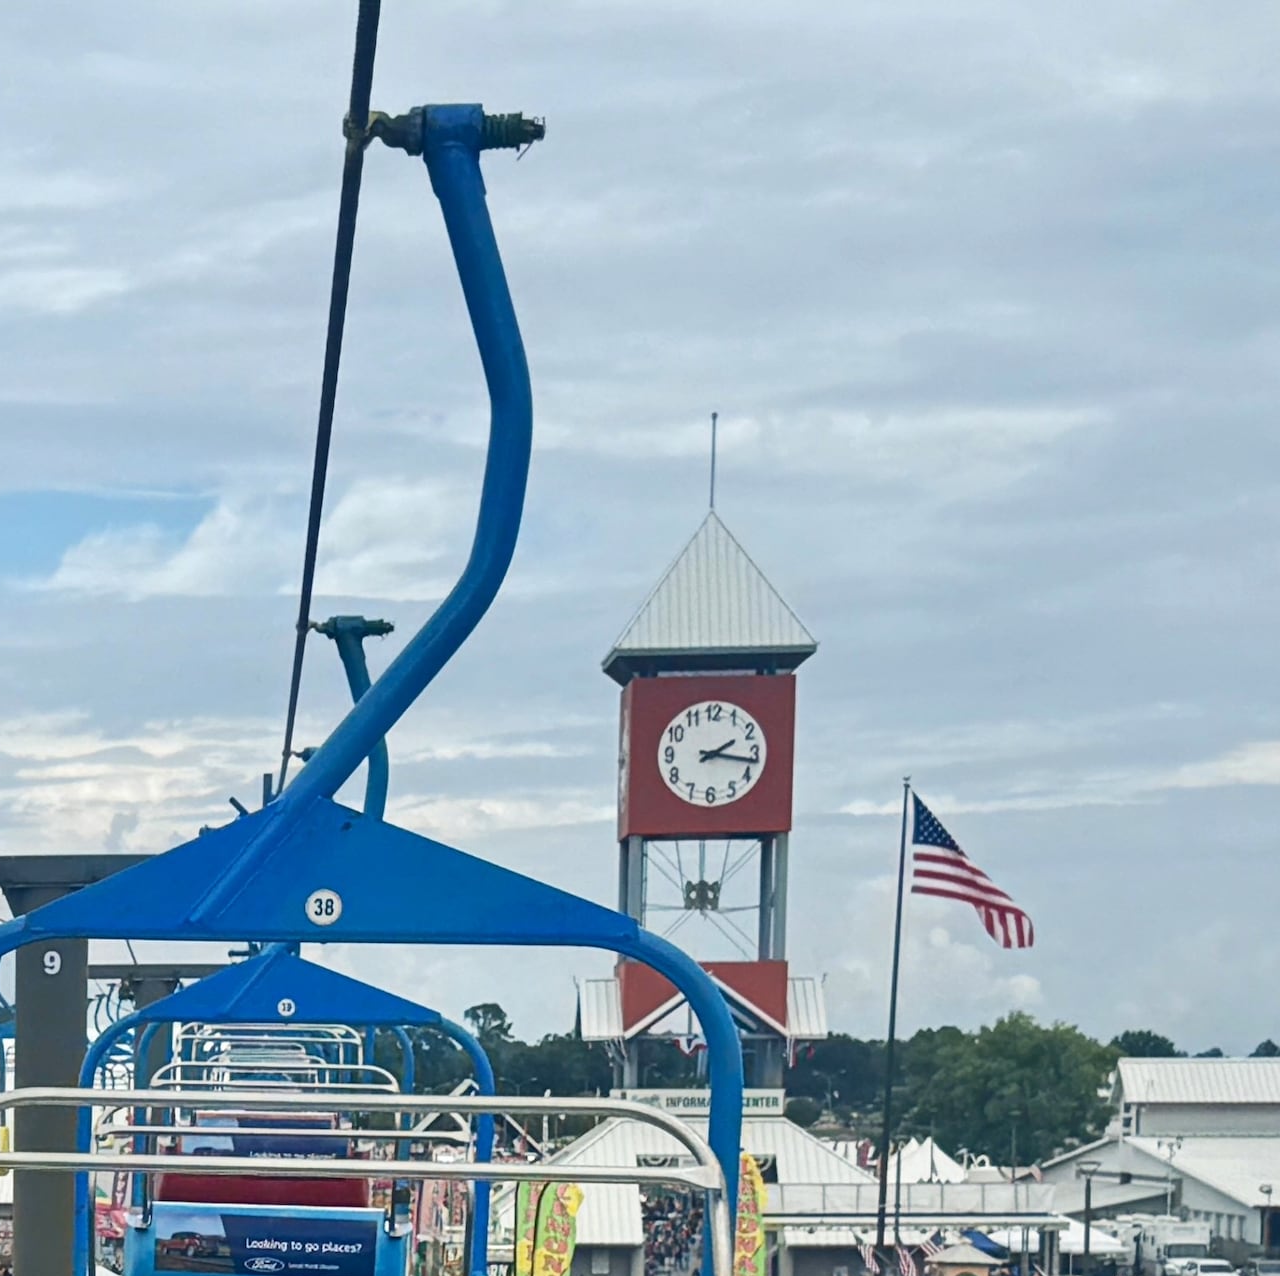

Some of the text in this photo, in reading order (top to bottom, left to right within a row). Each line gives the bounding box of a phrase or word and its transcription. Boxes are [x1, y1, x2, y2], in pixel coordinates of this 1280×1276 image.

[686, 709, 699, 727] 11
[705, 704, 722, 722] 12
[730, 709, 736, 727] 1
[668, 725, 684, 742] 10
[744, 722, 755, 740] 2
[664, 746, 675, 764] 9
[750, 744, 759, 762] 3
[669, 766, 679, 784] 8
[742, 765, 752, 783] 4
[686, 782, 695, 800] 7
[705, 786, 716, 804] 6
[726, 781, 736, 798] 5
[313, 898, 334, 916] 38
[42, 950, 62, 975] 9
[666, 1096, 711, 1108] INFORMA
[743, 1096, 780, 1108] ENTER
[245, 1238, 363, 1254] Looking to go places?
